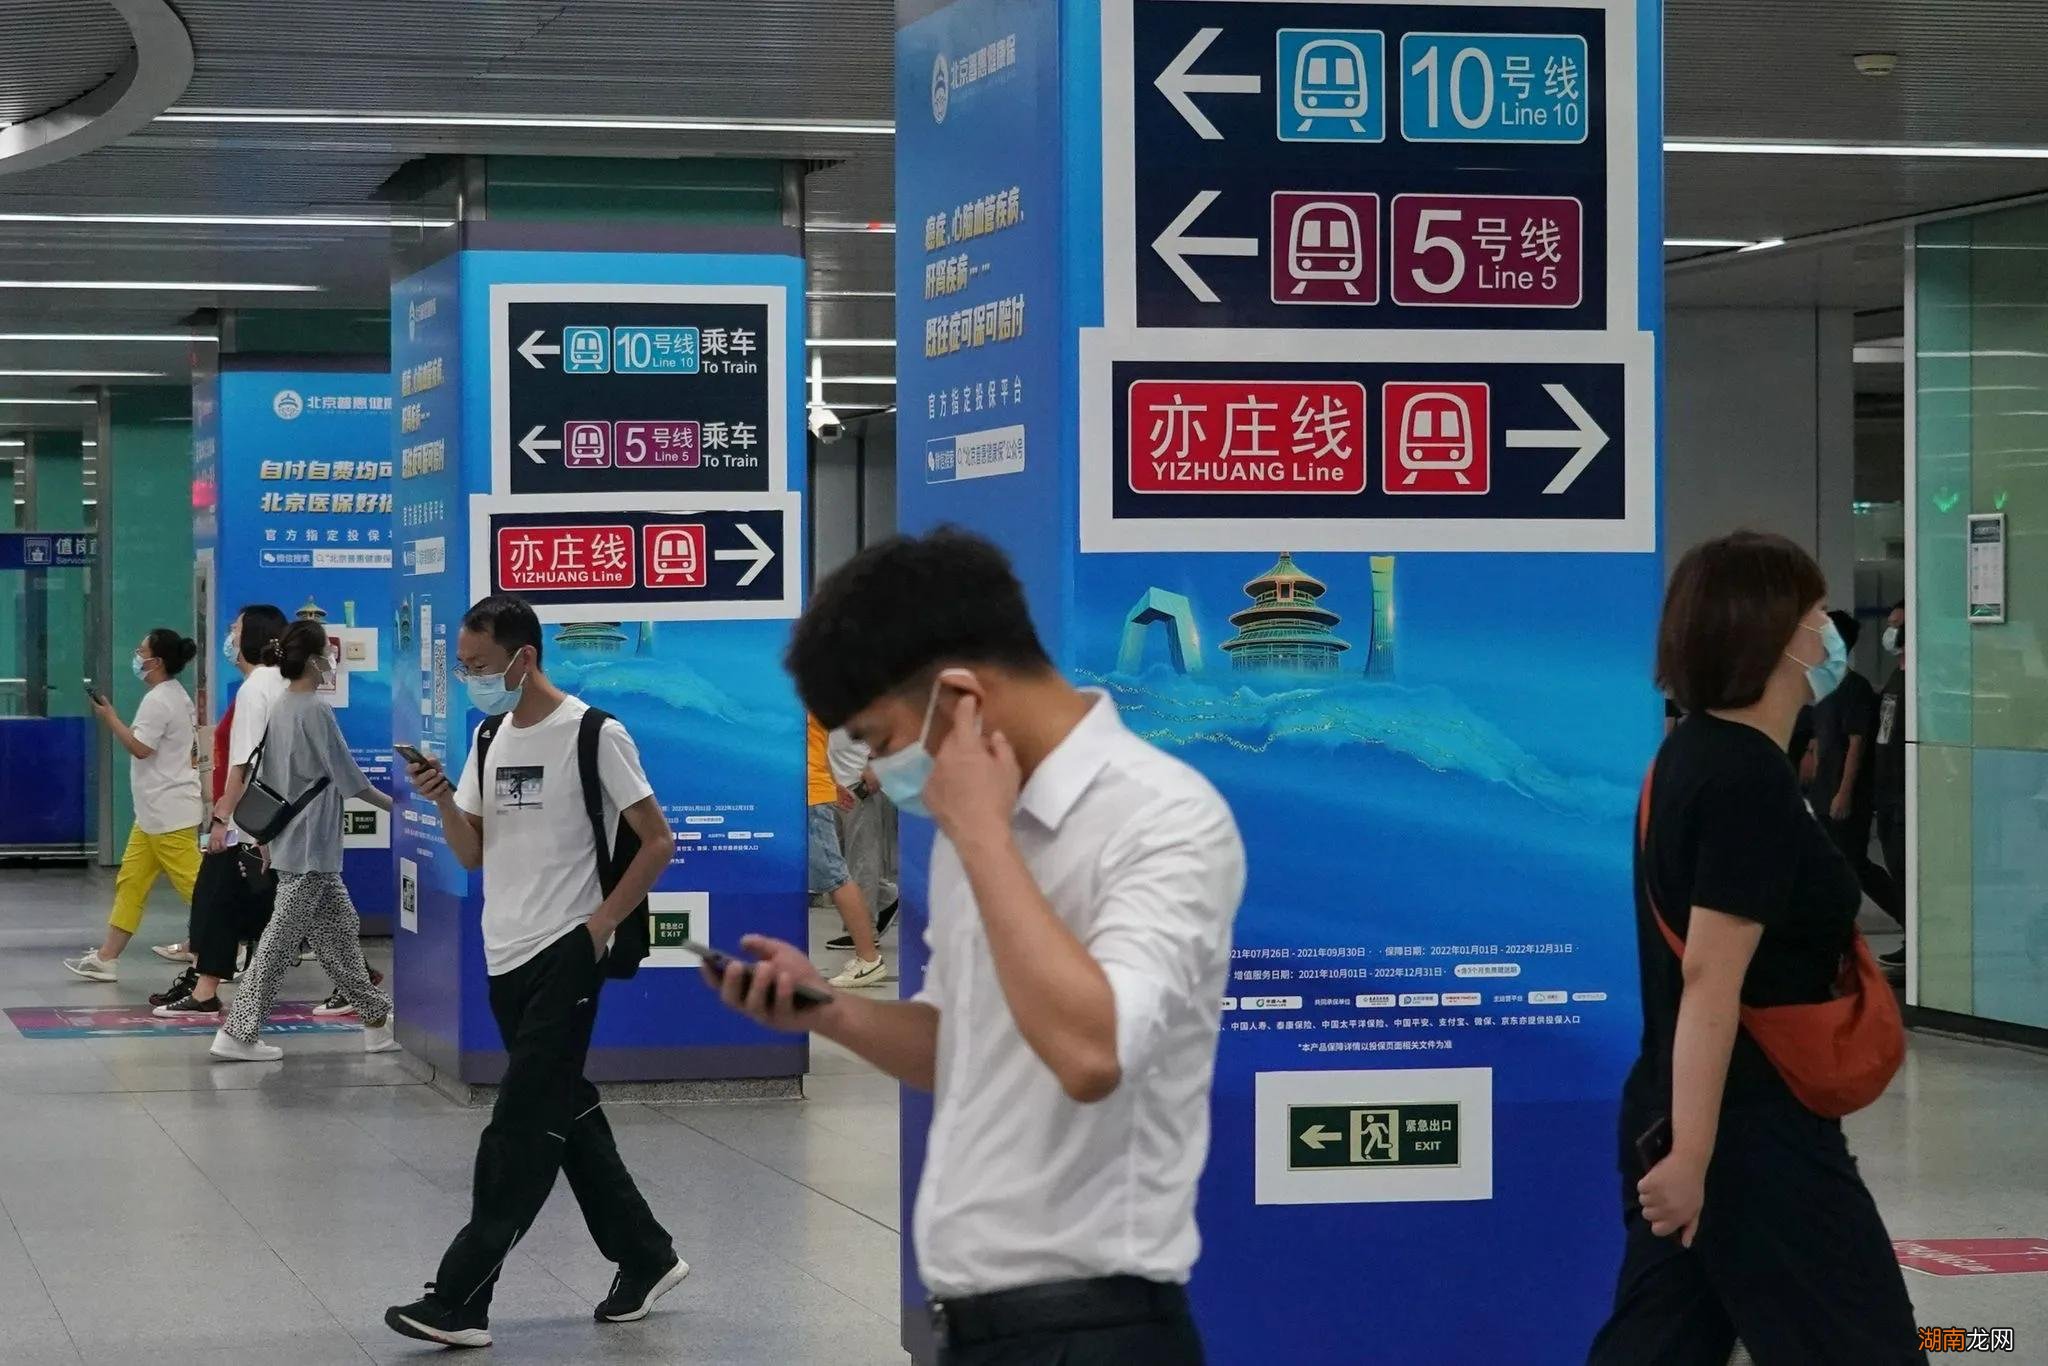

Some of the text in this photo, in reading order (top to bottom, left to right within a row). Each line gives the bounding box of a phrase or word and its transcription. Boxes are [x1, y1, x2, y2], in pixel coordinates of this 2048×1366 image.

[1410, 46, 1579, 129] 10号线
[1502, 103, 1579, 127] Line 10
[1411, 209, 1563, 294] 5号线
[1478, 264, 1558, 290] Line 5
[616, 328, 757, 369] 10号线 乘车
[652, 357, 694, 368] Line 10
[702, 361, 757, 374] To Train
[928, 375, 1022, 419] 官方指定投保平台
[1149, 393, 1353, 460] 亦庄线
[625, 422, 758, 463] 5号线 乘车
[655, 450, 689, 462] Line 5
[703, 454, 758, 468] To Train
[1152, 460, 1344, 482] YIZHUANG Line
[265, 529, 393, 542] 官方指定投保
[509, 533, 627, 572] 亦庄线
[512, 570, 623, 583] YIZHUANG Line
[661, 930, 682, 938] EXIT
[1405, 1119, 1452, 1133] 紧急出口
[1415, 1141, 1442, 1151] EXIT
